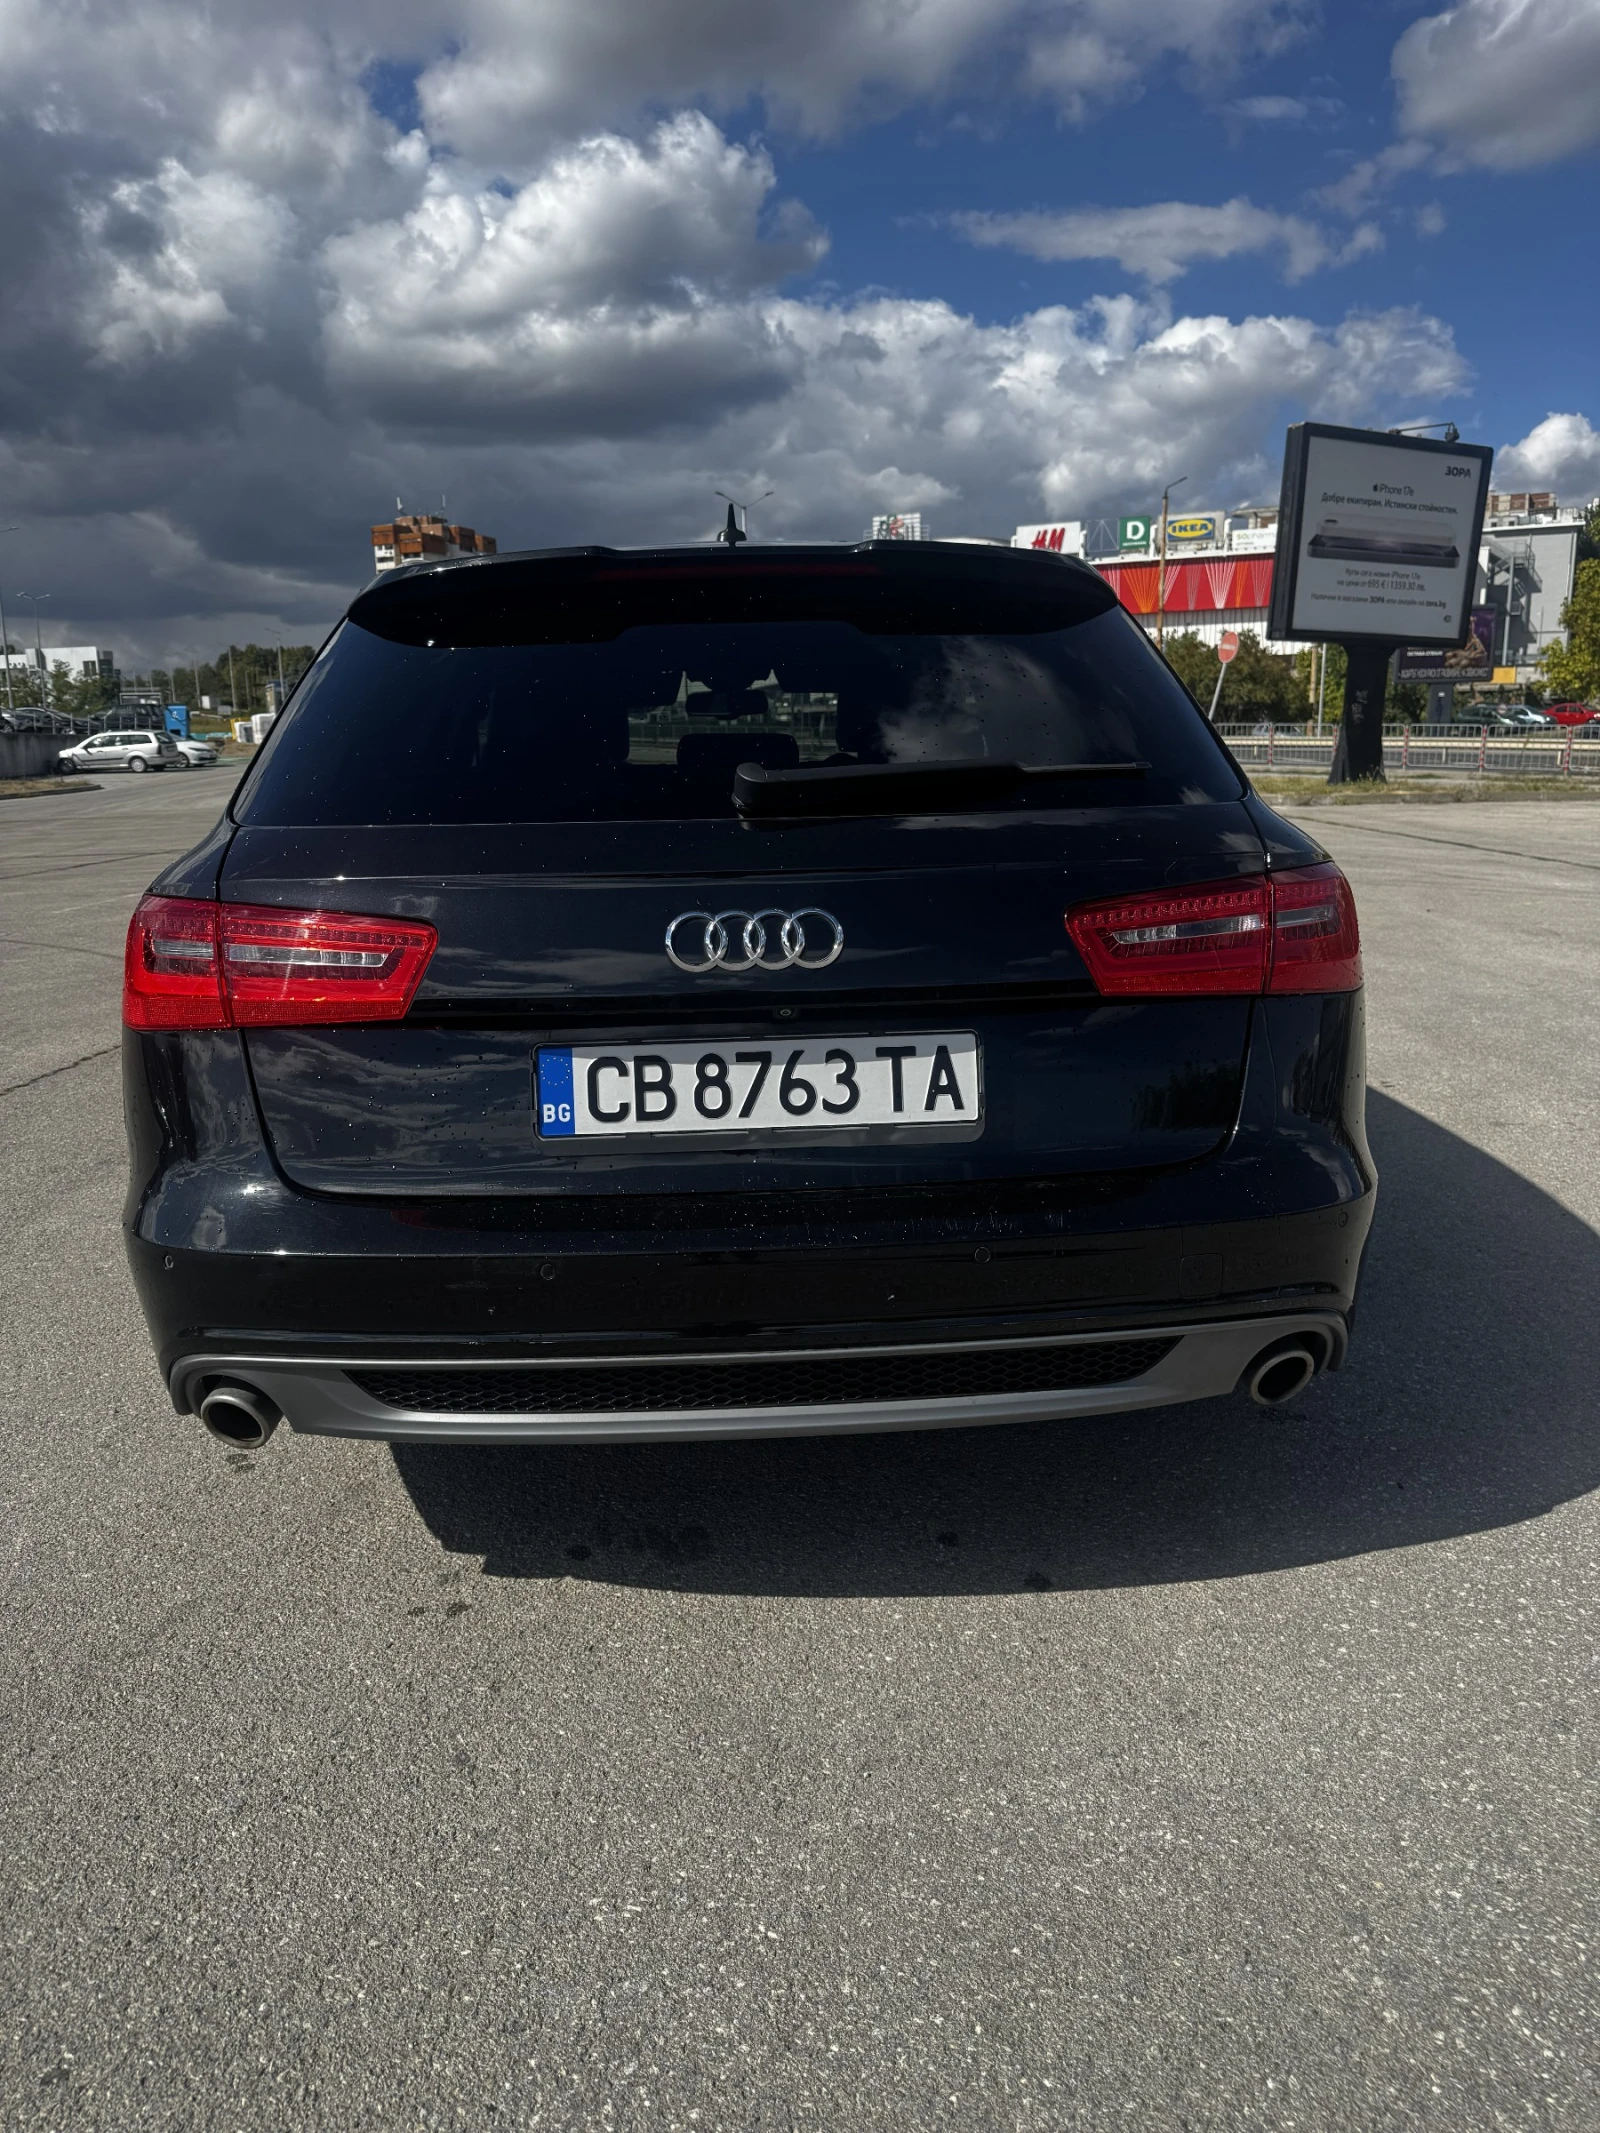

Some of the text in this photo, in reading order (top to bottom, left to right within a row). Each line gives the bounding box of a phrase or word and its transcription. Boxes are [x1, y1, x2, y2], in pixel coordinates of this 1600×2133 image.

[1445, 466, 1472, 479] ЗОРА
[1379, 484, 1402, 496] iPhone
[1321, 492, 1345, 505] Добре
[1126, 520, 1145, 540] D
[1172, 523, 1209, 533] IKEA
[1031, 528, 1065, 552] HM
[543, 1044, 965, 1123] BG CB 8763 TA
